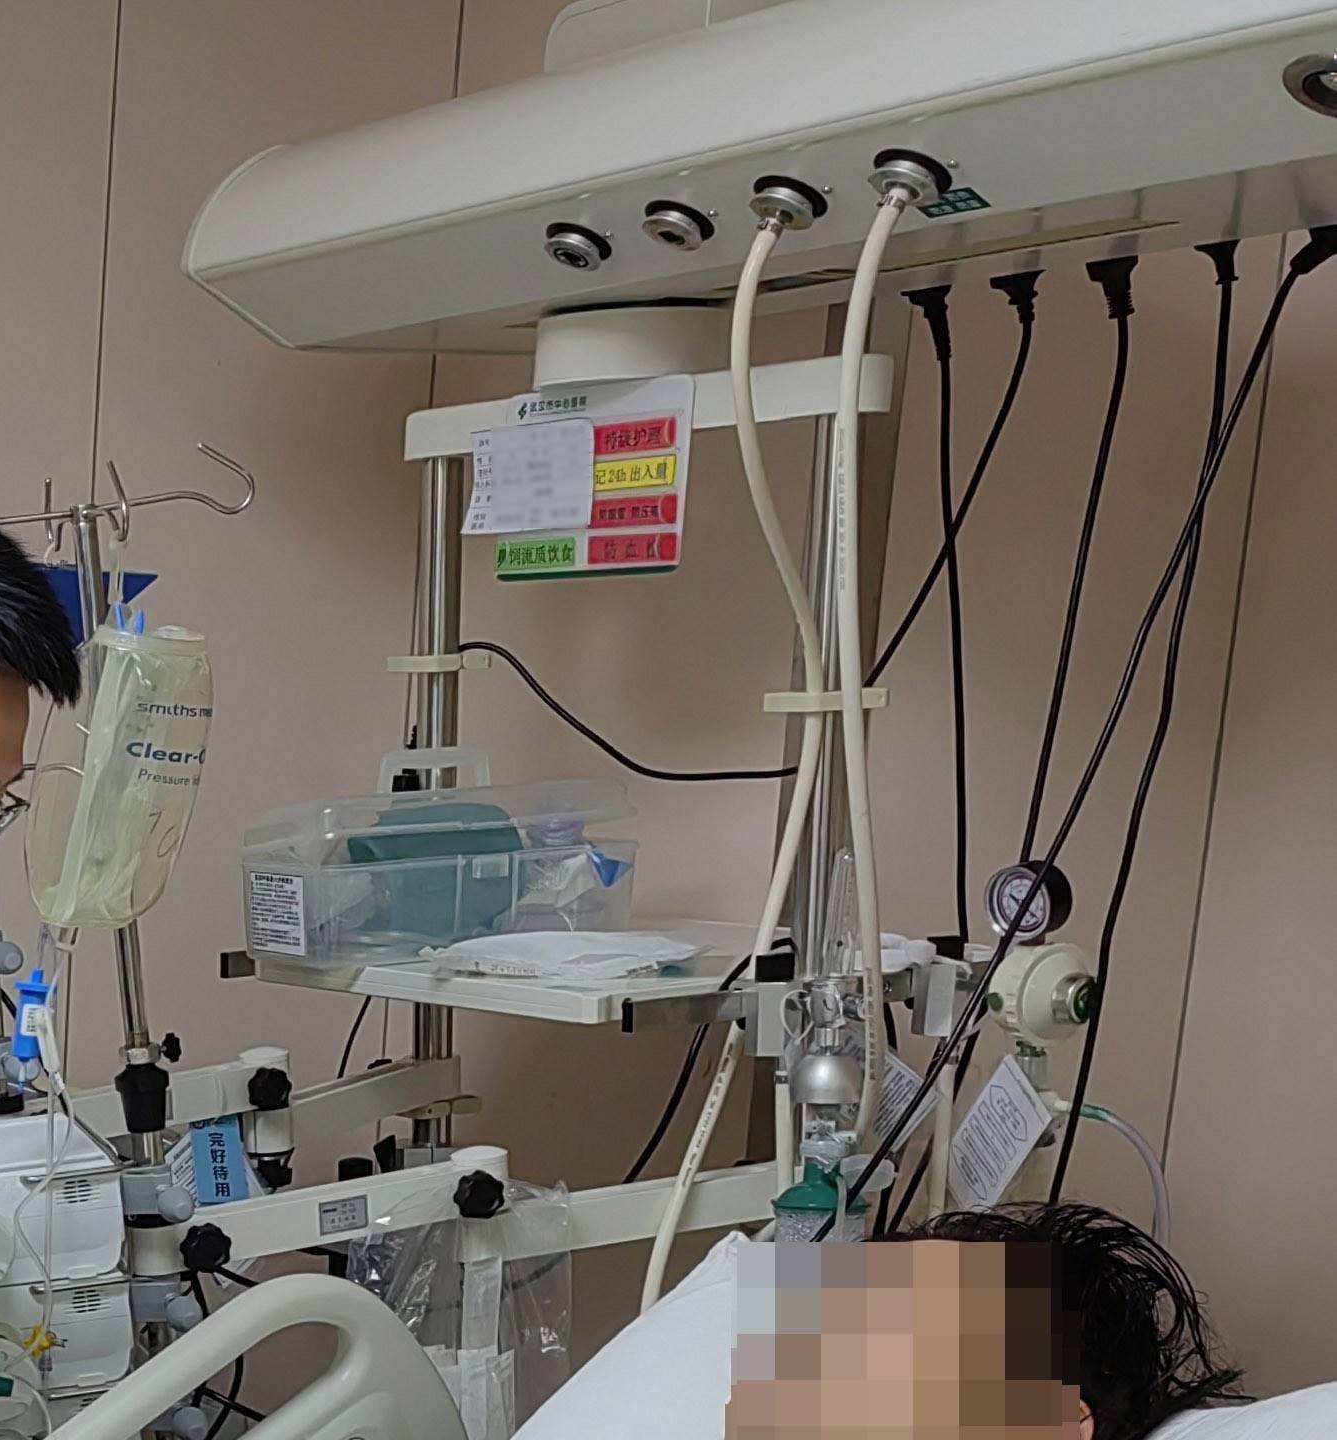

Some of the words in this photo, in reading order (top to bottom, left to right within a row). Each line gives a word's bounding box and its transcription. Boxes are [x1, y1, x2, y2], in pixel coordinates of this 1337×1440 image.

[136, 702, 197, 718] smiths
[137, 768, 191, 786] Pressure
[208, 1132, 231, 1198] 完好待用
